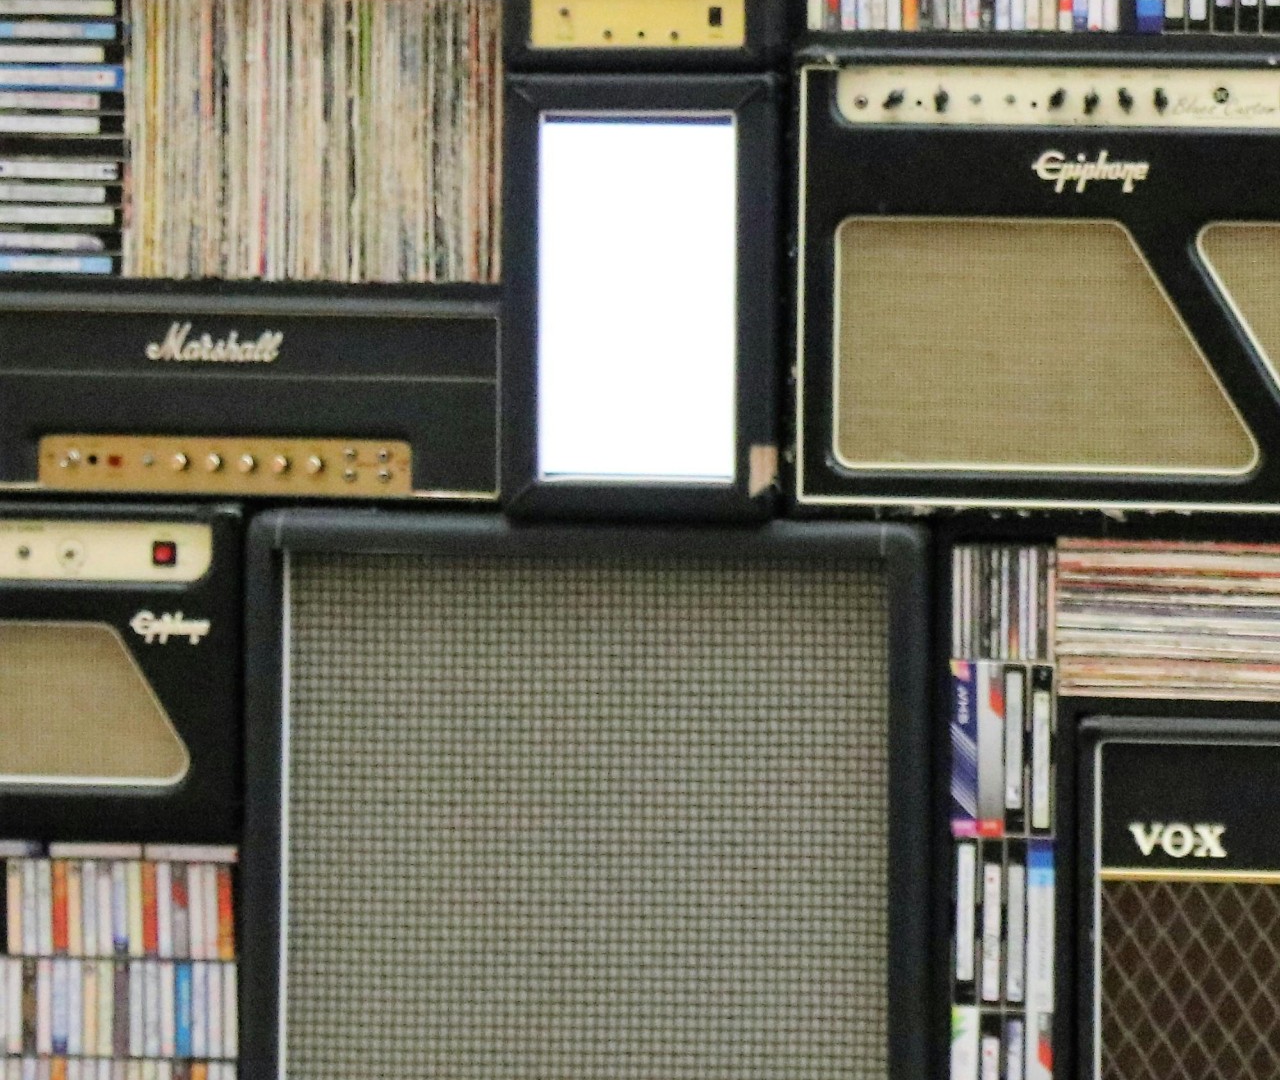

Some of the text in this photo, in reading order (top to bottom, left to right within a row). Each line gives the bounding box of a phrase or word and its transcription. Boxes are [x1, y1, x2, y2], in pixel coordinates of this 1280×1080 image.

[1032, 149, 1150, 193] Epiphone
[146, 322, 284, 363] Marshall
[1130, 822, 1227, 858] VOX
